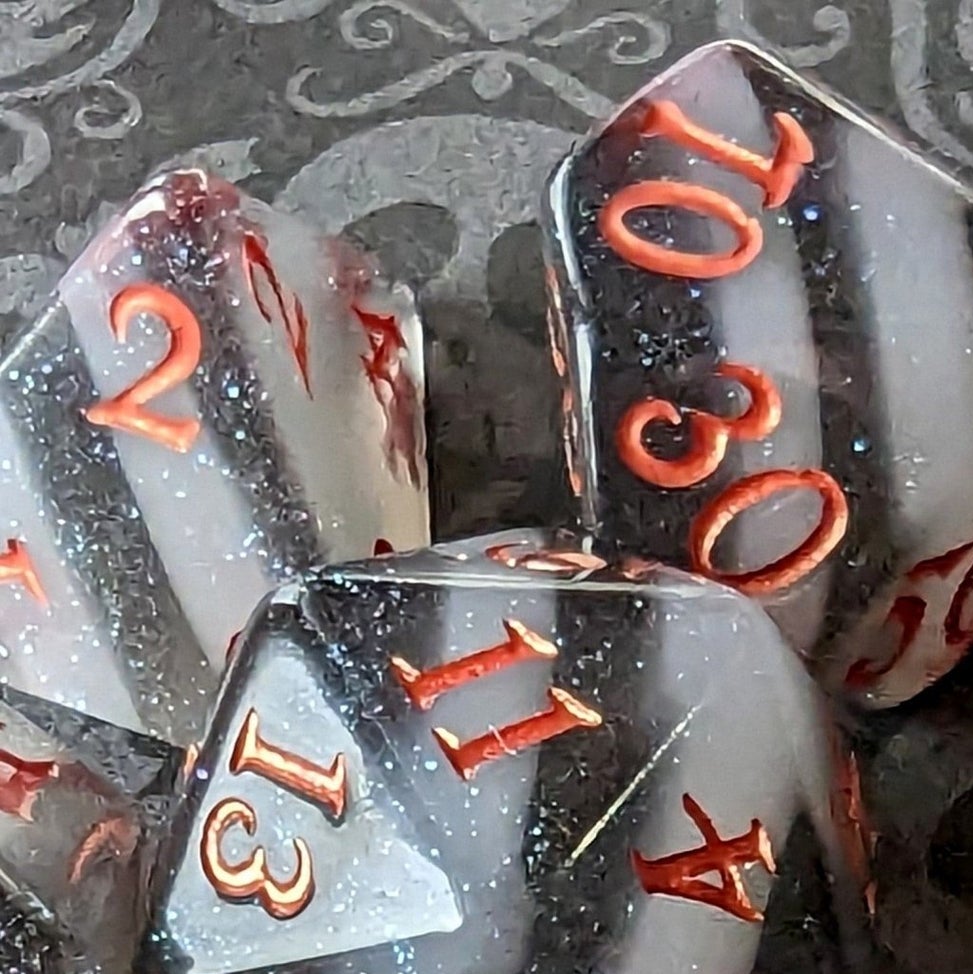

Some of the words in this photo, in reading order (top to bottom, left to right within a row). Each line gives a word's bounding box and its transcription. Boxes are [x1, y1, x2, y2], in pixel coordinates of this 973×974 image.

[598, 98, 815, 279] 10
[80, 283, 203, 454] 2
[615, 360, 849, 596] 30
[390, 617, 604, 783] 11
[198, 708, 349, 922] 13
[629, 792, 777, 924] 4
